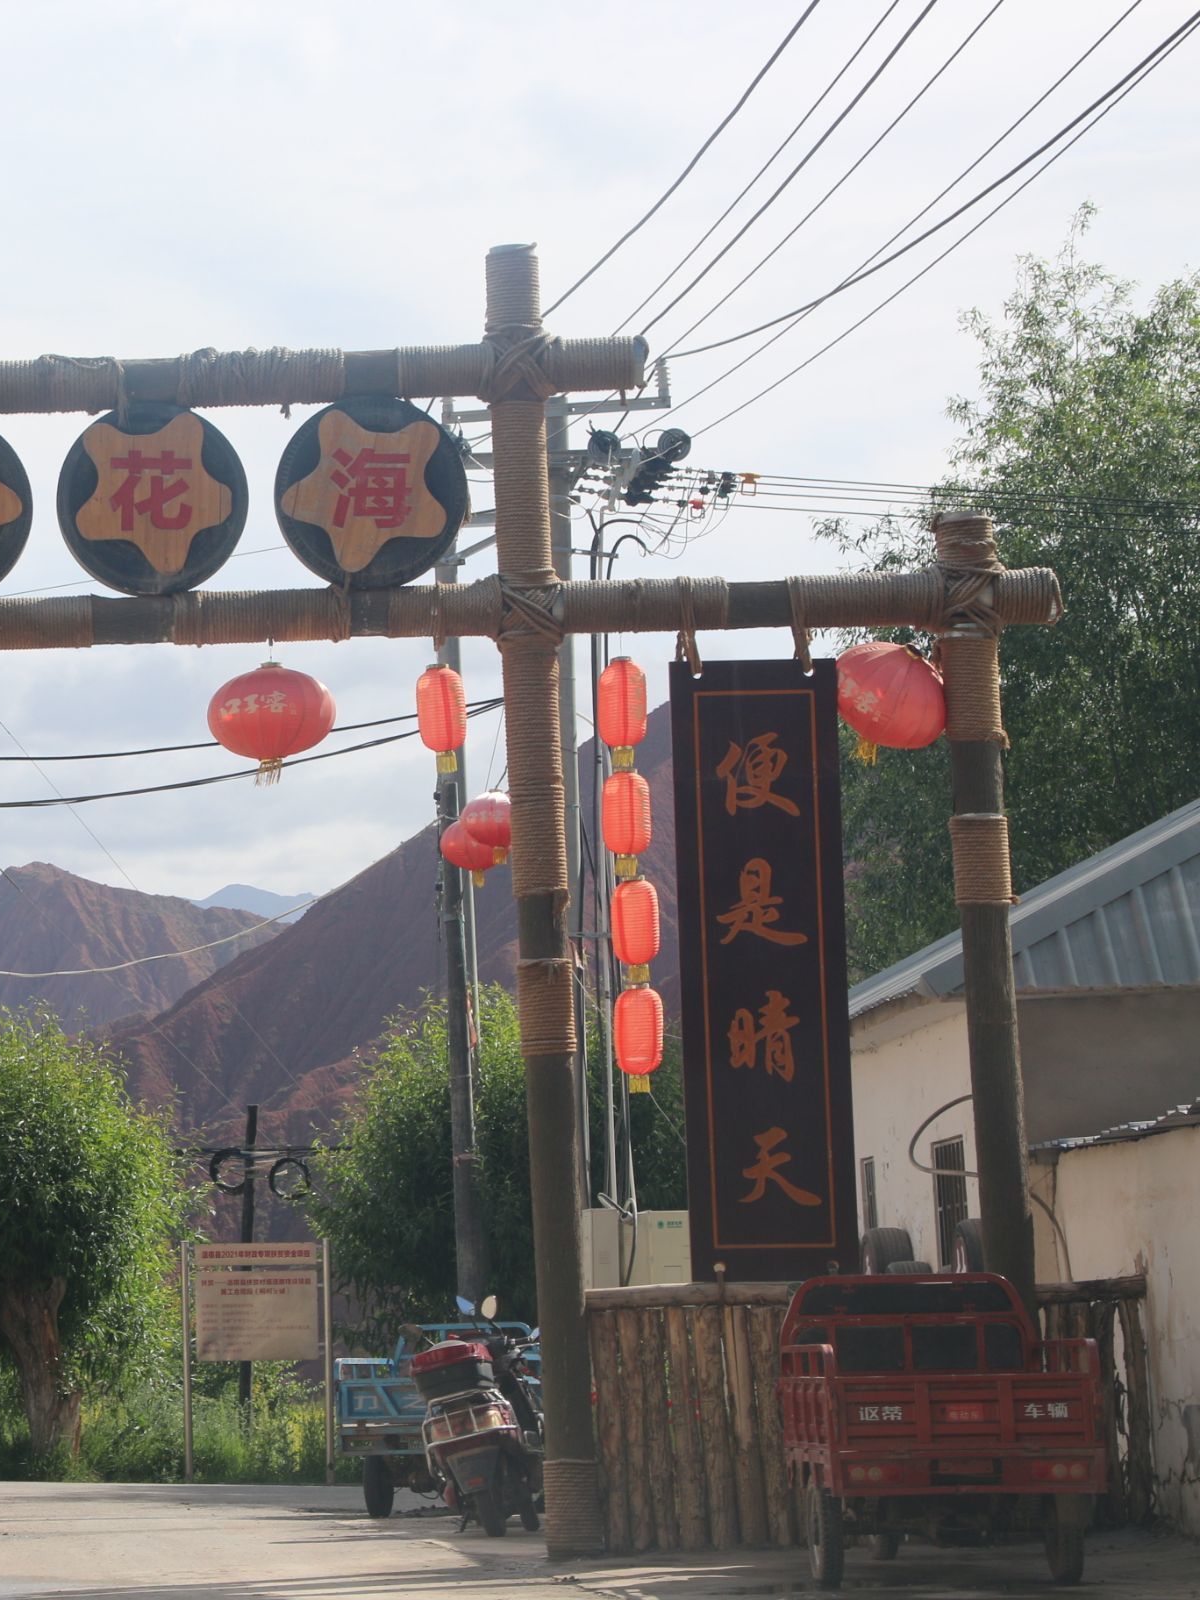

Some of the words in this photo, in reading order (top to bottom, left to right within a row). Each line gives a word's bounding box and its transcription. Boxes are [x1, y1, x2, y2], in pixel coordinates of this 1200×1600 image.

[716, 731, 823, 1206] 便是晴天
[1023, 1402, 1069, 1419] 车辆
